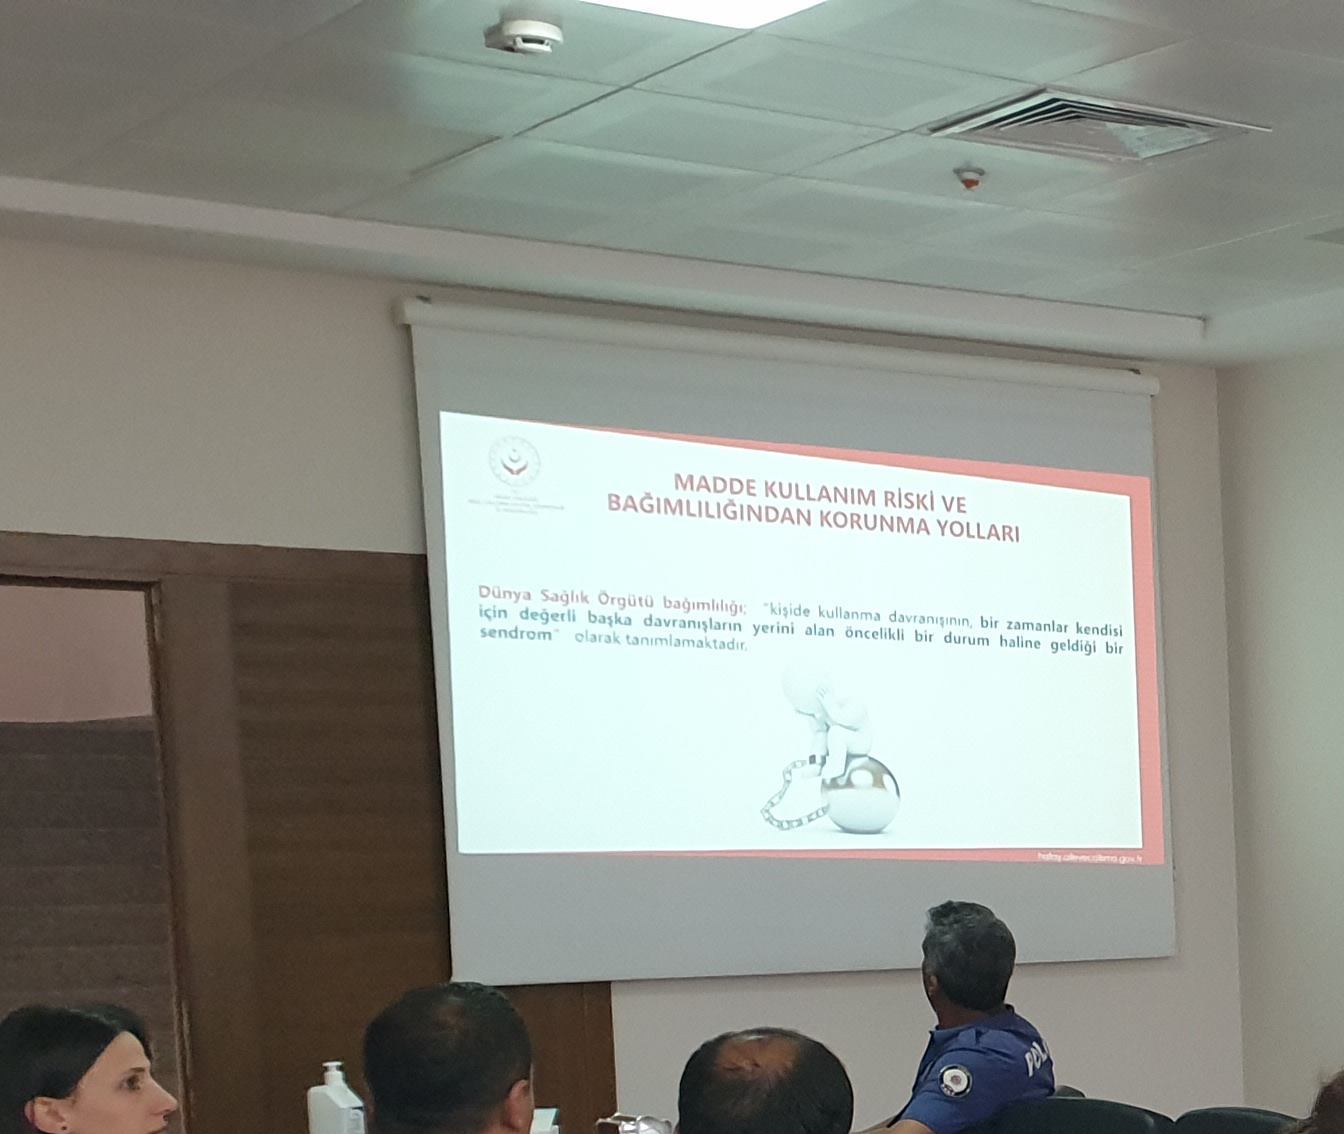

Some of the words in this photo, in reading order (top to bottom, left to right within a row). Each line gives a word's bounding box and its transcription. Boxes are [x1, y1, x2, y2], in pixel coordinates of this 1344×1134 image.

[606, 491, 812, 527] BAĞIMLILIĞINDAN
[819, 509, 931, 536] KORUNMA
[936, 518, 1020, 543] YOLLARI
[673, 472, 757, 497] MADDE
[763, 479, 876, 507] KULLANIM
[883, 487, 935, 512] RİSKİ
[941, 494, 967, 514] VE
[478, 585, 532, 603] Dünya
[540, 589, 590, 607] Sağlık
[597, 590, 654, 611] Örgütü
[818, 605, 881, 622] kullanma
[980, 616, 1000, 630] bir
[1006, 620, 1069, 634] zamanlar
[1075, 622, 1124, 638] kendisi
[478, 603, 508, 622] için
[519, 606, 577, 626] değerli
[587, 609, 633, 628] başka
[643, 613, 742, 633] davranışların
[752, 621, 795, 637] yerini
[804, 623, 835, 637] alan
[845, 626, 905, 642] öncelikli
[914, 629, 935, 643] bir
[943, 631, 990, 647] durum
[999, 634, 1042, 650] haline
[1050, 639, 1097, 656] geldiği
[1105, 641, 1124, 655] bir
[574, 629, 622, 645] olarak
[625, 631, 748, 652] tanımlamaktadır.
